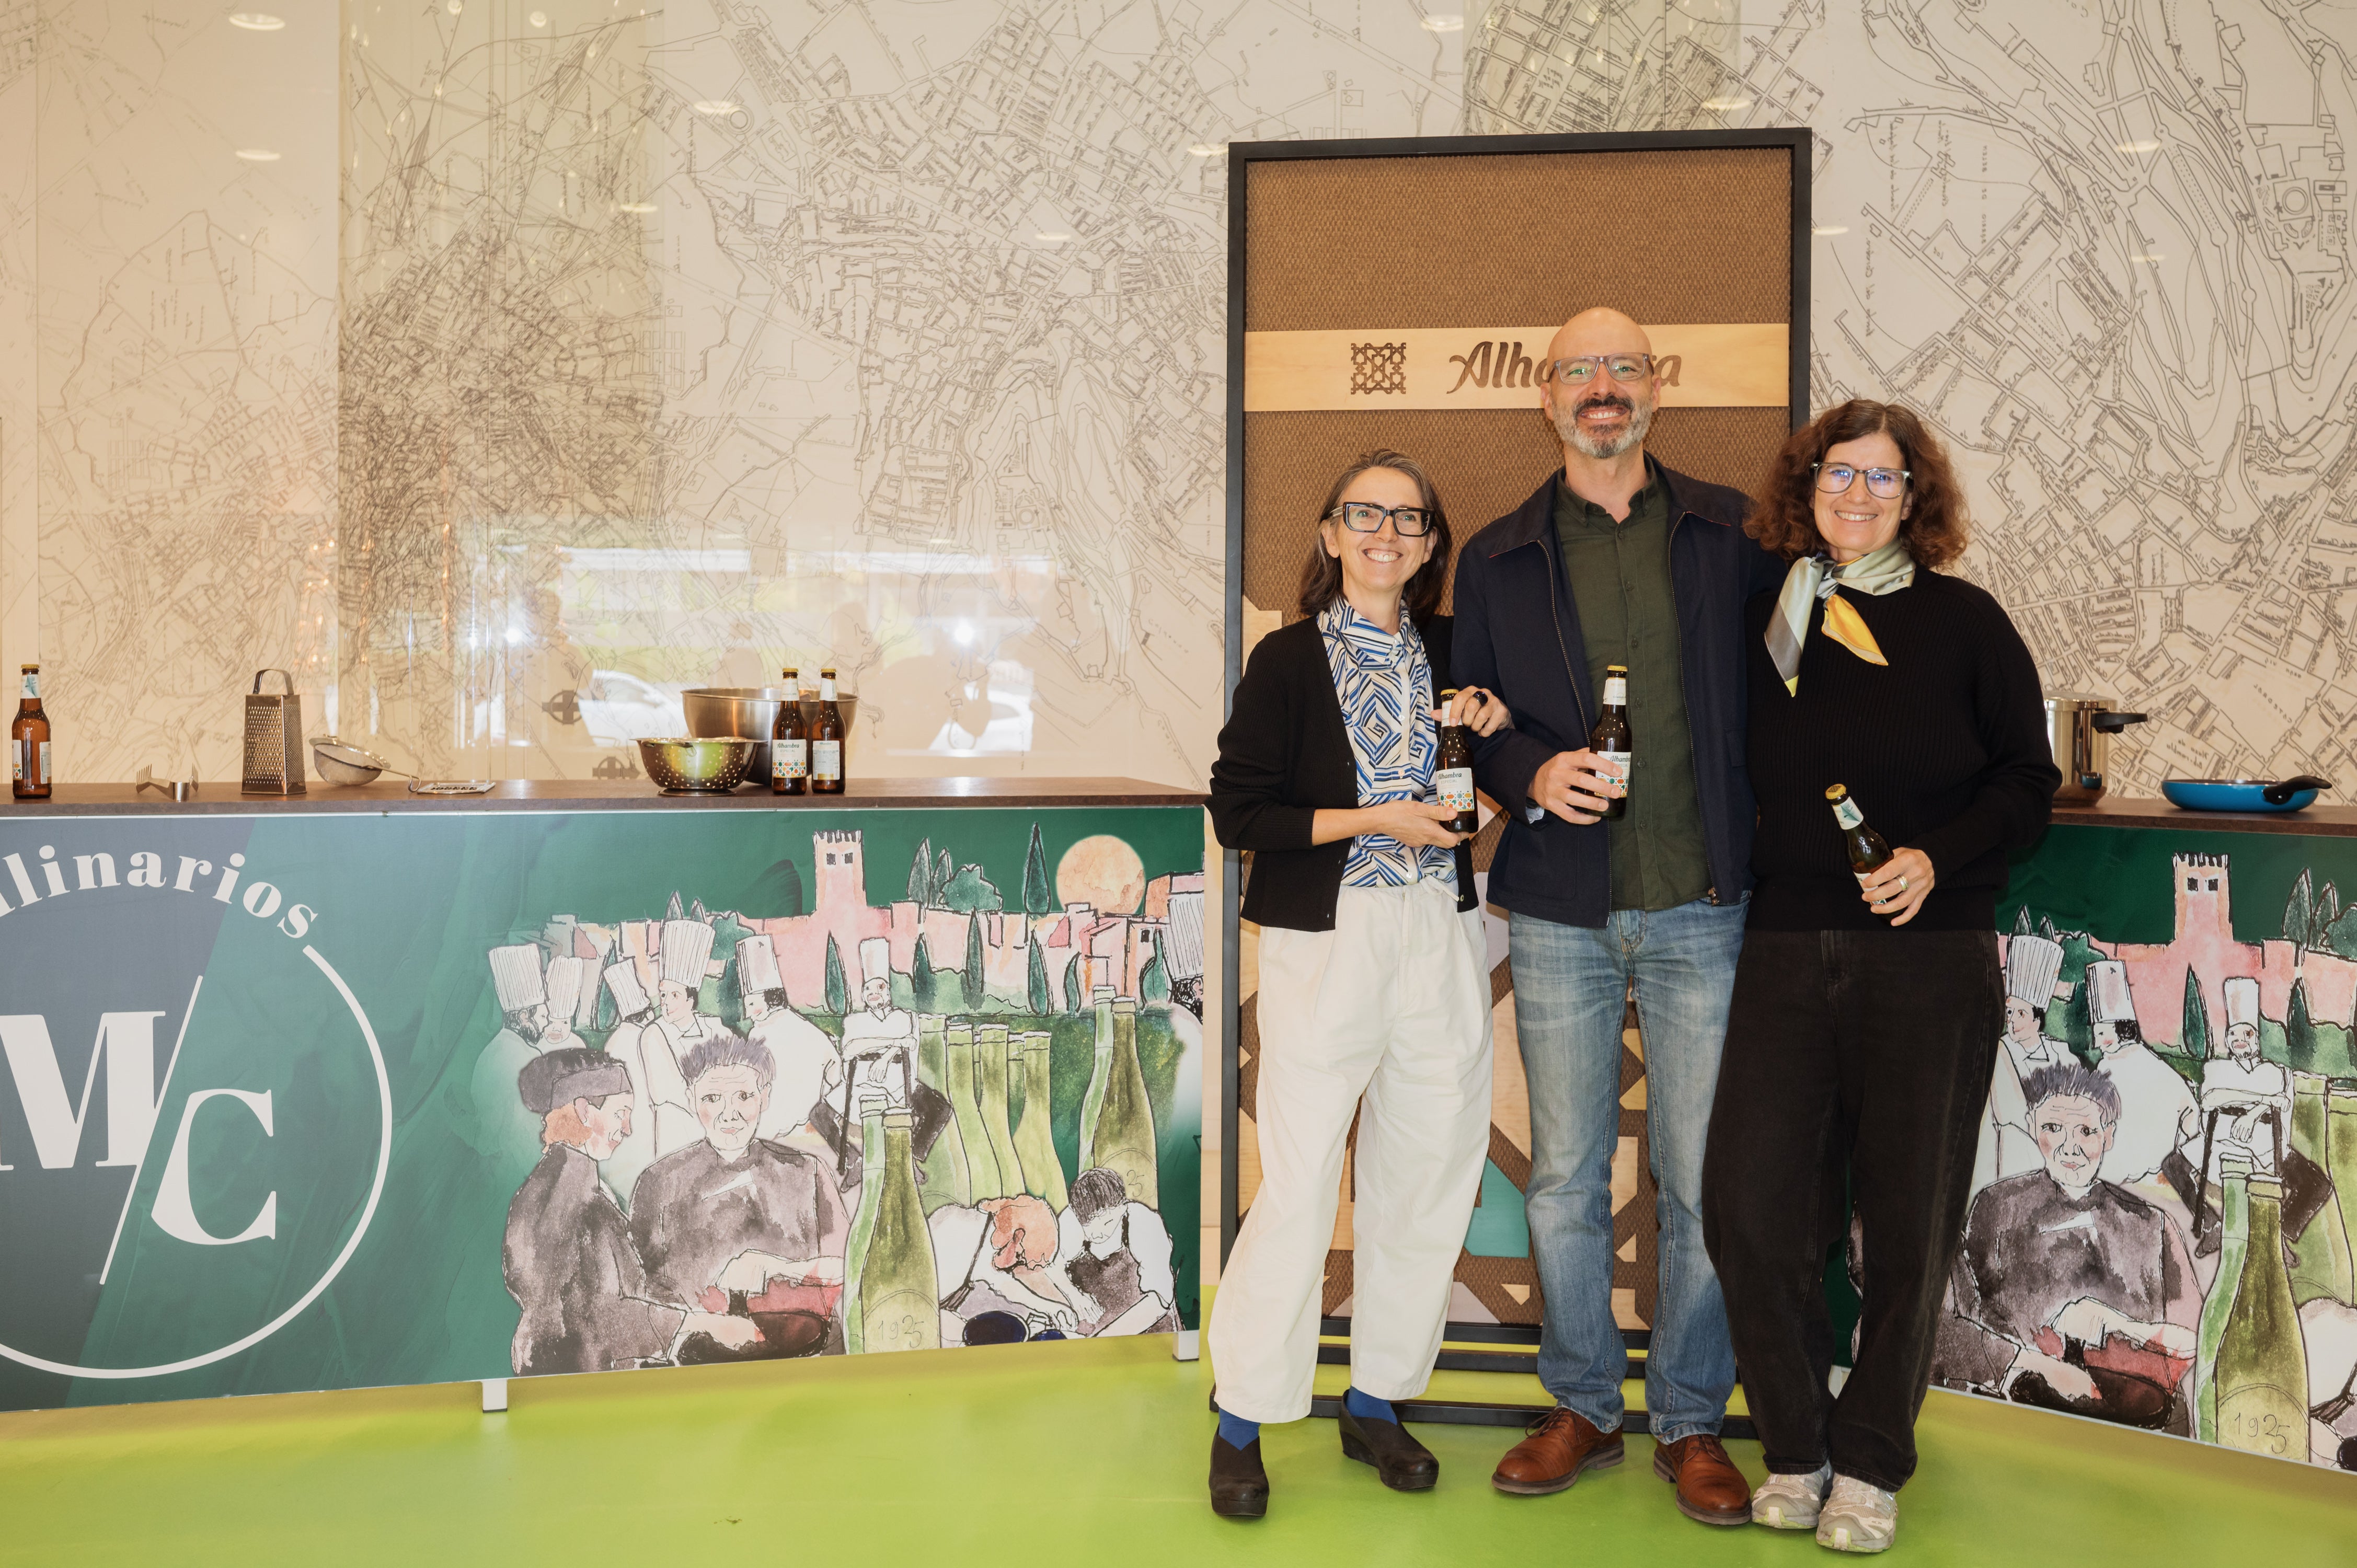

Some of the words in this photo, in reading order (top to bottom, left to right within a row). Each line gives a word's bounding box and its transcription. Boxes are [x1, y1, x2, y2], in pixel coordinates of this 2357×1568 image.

[1438, 771, 1462, 780] Alhambra
[878, 1315, 924, 1349] 1925
[2234, 1412, 2291, 1455] 1925
